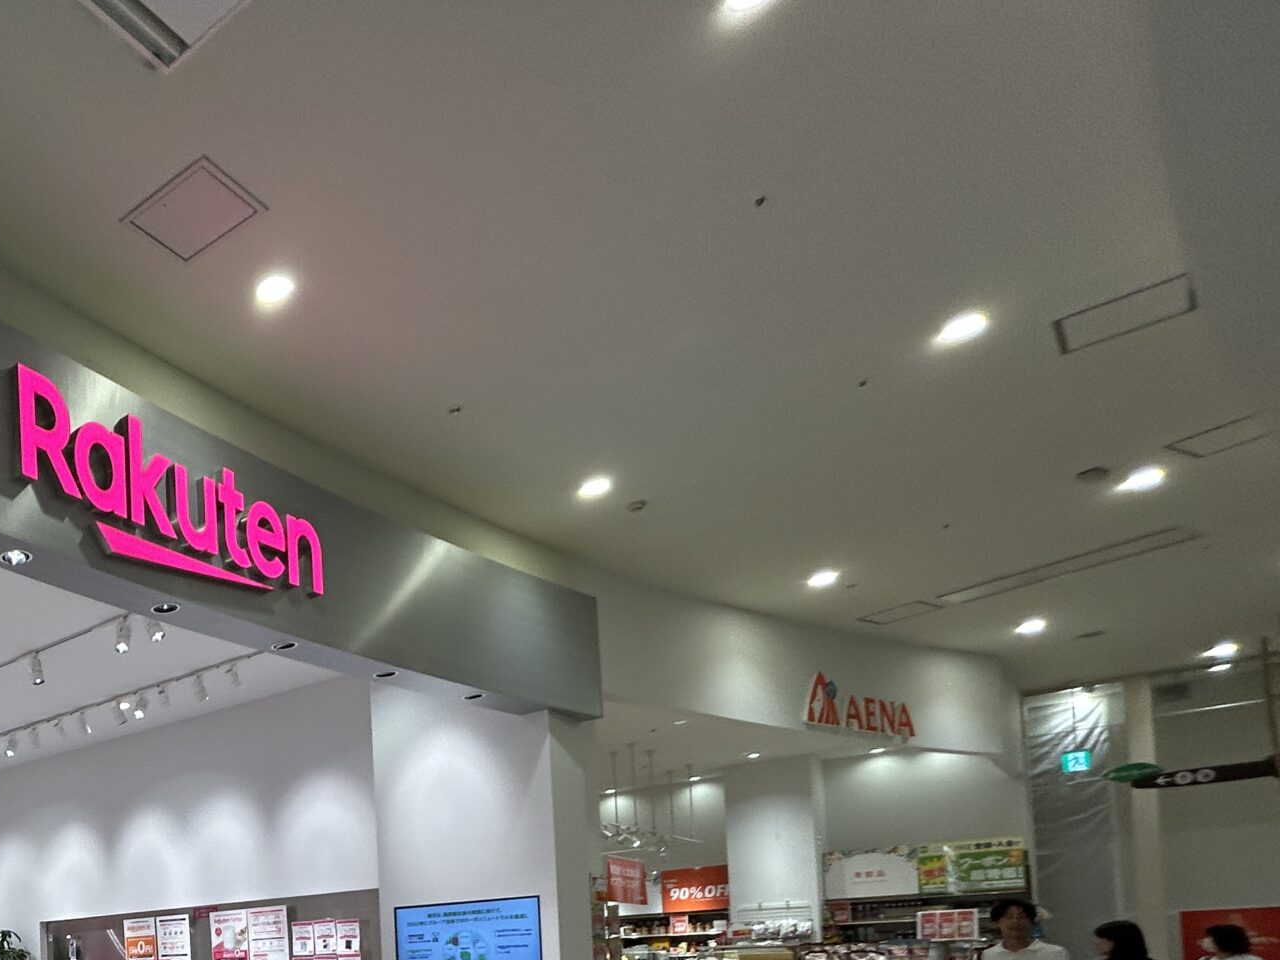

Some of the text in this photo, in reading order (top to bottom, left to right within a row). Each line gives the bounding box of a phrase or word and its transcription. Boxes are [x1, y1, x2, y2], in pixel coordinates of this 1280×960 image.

[16, 362, 324, 596] Rakuten
[845, 694, 917, 737] AENA
[669, 884, 704, 900] 90%
